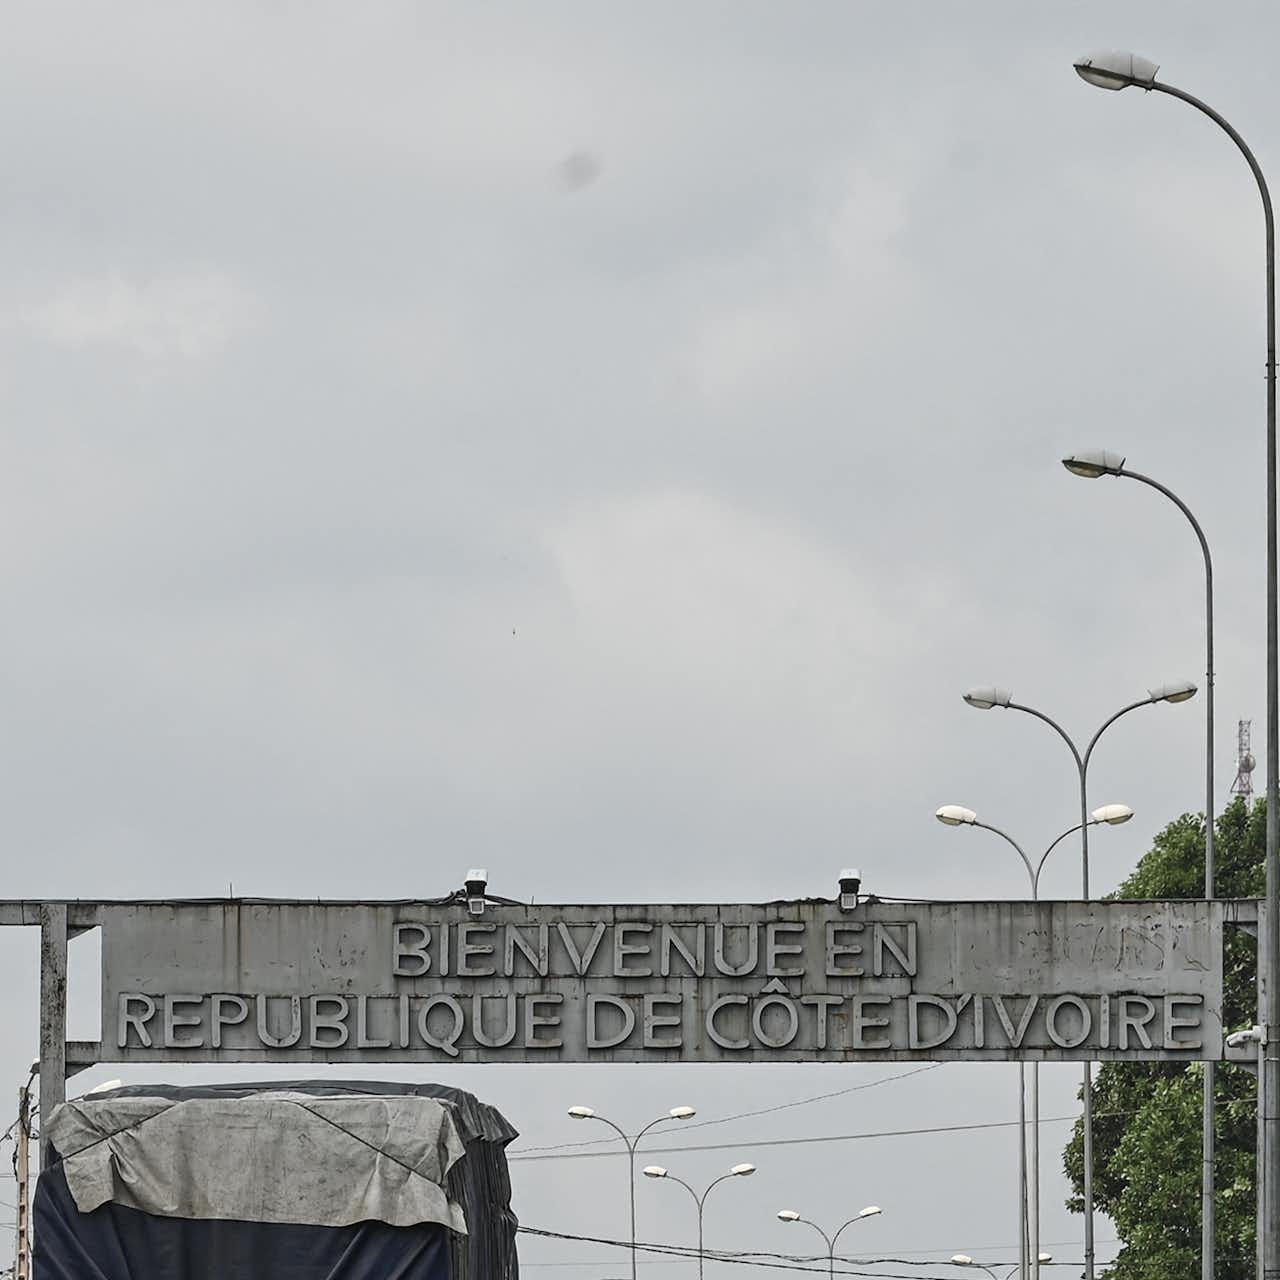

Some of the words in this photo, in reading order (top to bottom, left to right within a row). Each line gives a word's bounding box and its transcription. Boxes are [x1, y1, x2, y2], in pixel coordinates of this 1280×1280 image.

[392, 921, 806, 977] BIENVENUE
[824, 921, 918, 977] EN
[117, 992, 564, 1057] REPUBLIQUE
[586, 993, 682, 1049] DE
[705, 976, 893, 1050] CÔTE
[909, 992, 1204, 1050] D'IVOIRE
